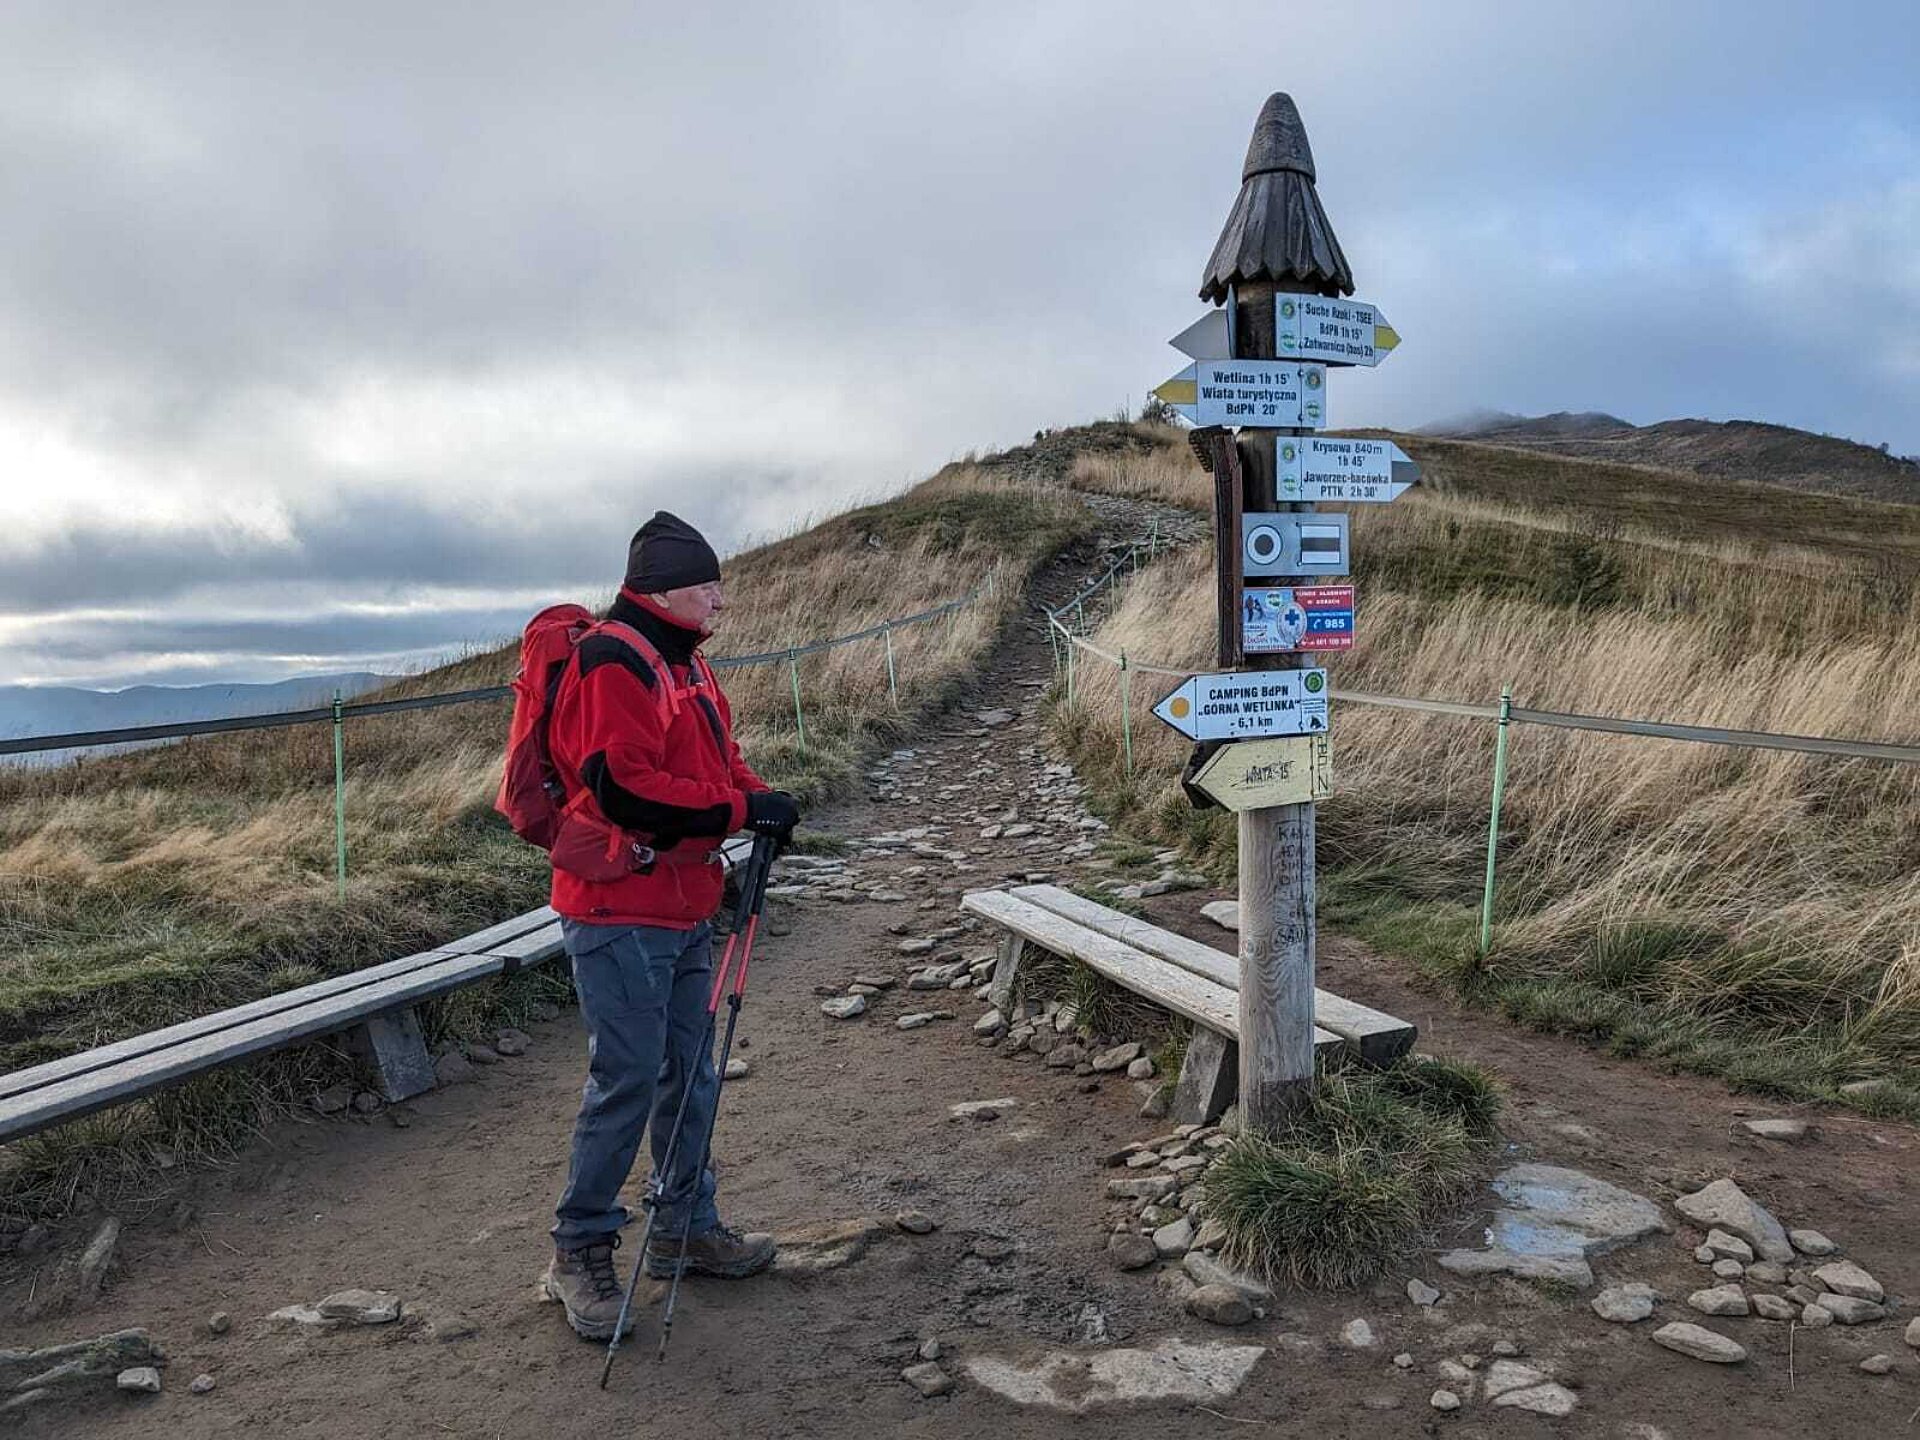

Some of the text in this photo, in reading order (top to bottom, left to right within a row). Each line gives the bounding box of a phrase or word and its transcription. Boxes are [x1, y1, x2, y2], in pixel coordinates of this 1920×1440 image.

[1213, 371, 1255, 384] Wetlina
[1202, 387, 1297, 402] Wiata turystyczna
[1226, 403, 1255, 415] BdPN
[1320, 485, 1344, 498] PTTK
[1209, 685, 1289, 701] CAMPING BdPN
[1238, 718, 1254, 730] 6,1
[1258, 717, 1273, 728] km
